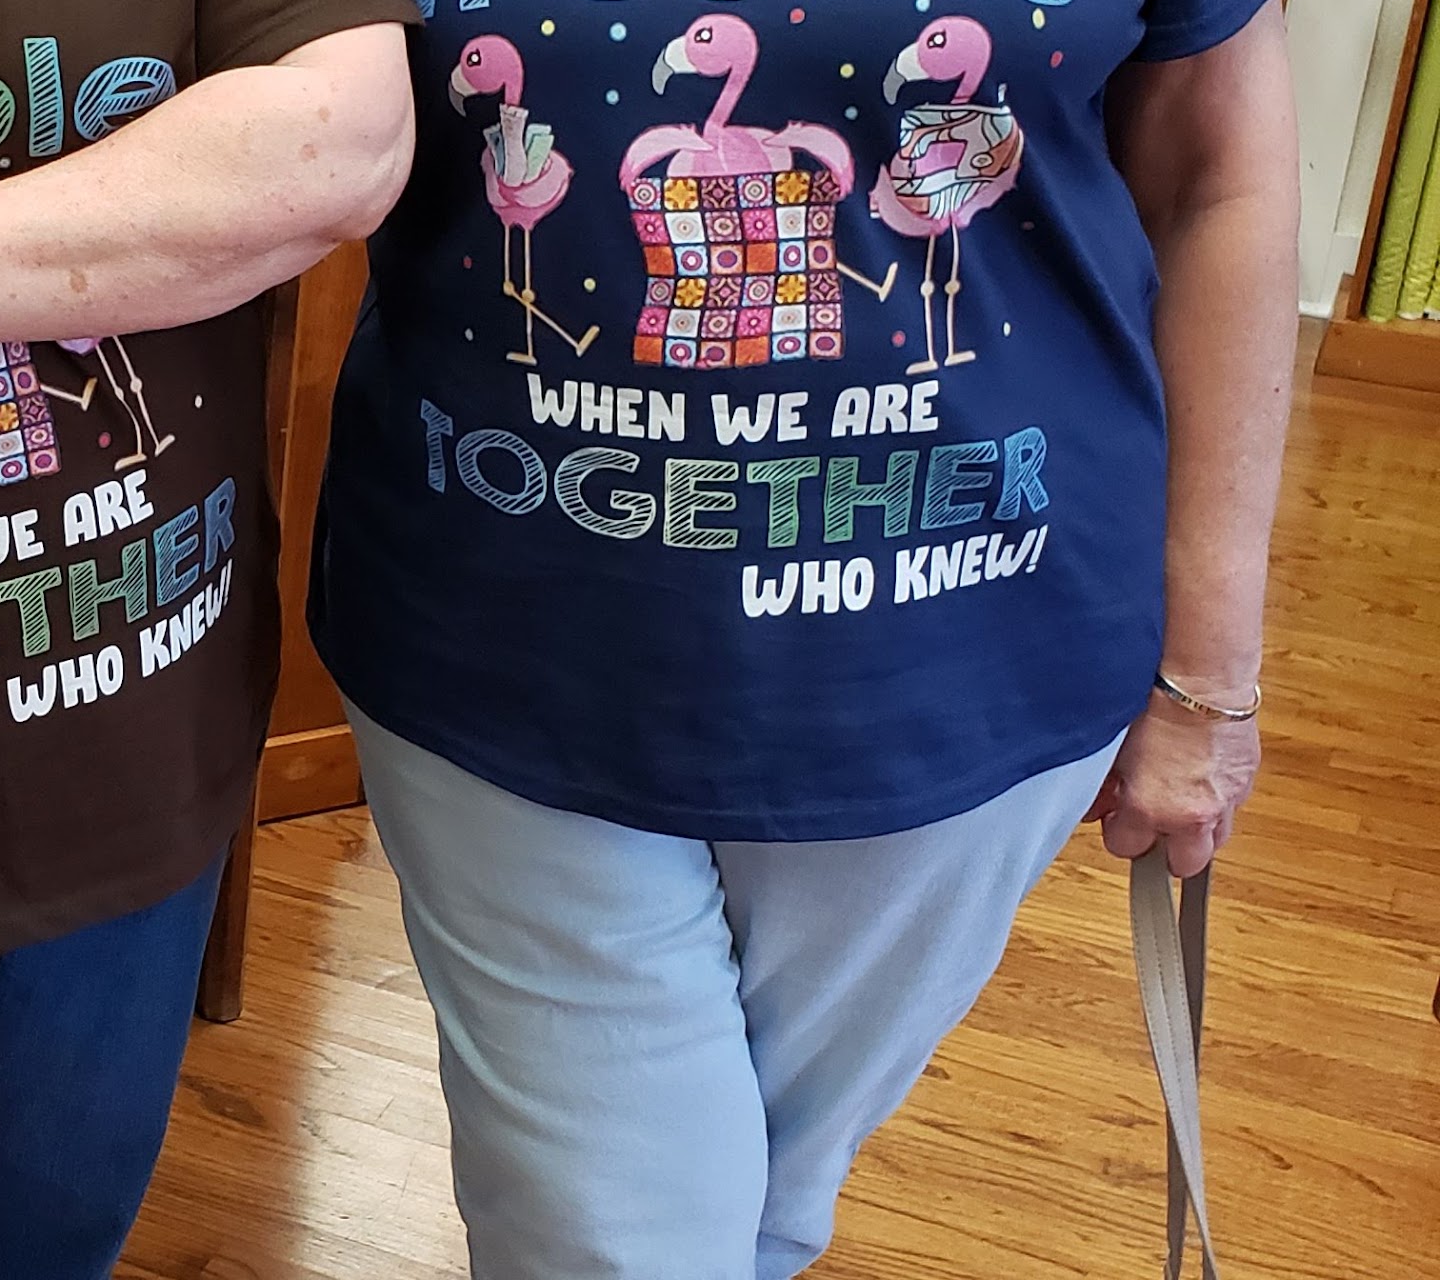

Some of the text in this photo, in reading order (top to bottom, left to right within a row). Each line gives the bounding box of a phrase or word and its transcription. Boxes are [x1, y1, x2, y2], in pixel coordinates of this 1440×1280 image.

[526, 373, 939, 446] WHEN WE ARE
[63, 469, 154, 547] ARE
[420, 398, 1050, 549] TOGETHER
[742, 525, 1049, 617] WHO KNEW!
[7, 645, 124, 723] WHO
